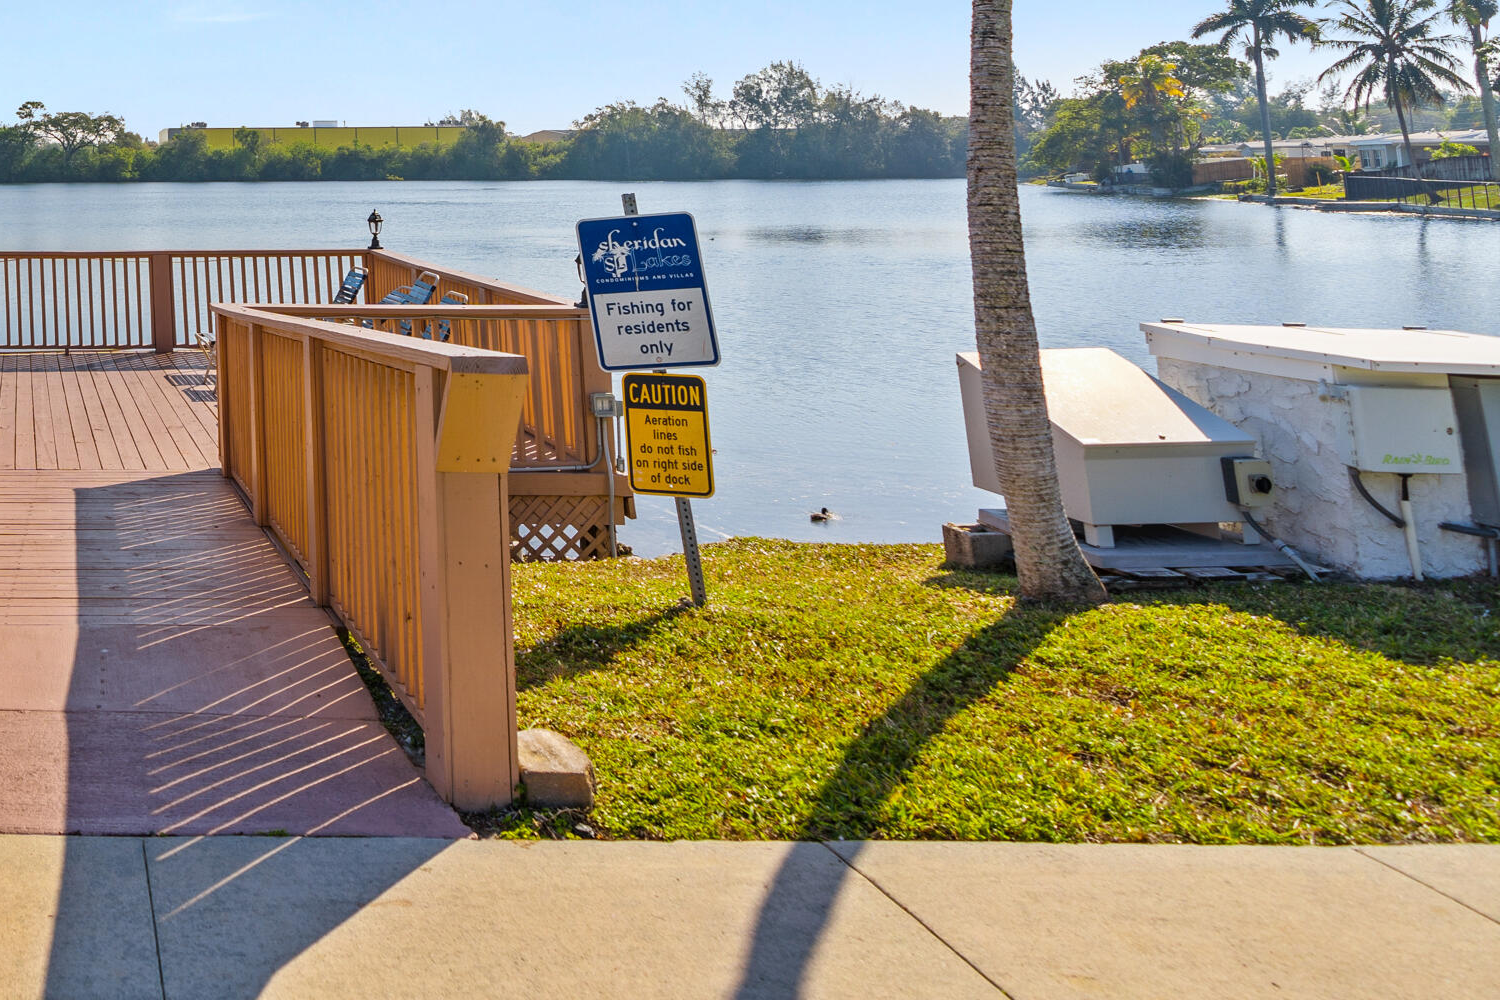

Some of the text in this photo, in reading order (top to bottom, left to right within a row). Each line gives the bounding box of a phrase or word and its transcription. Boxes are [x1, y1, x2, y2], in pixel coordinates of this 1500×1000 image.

[632, 246, 692, 272] Lakes
[606, 299, 693, 316] Fishing for
[617, 320, 690, 335] residents
[640, 340, 673, 356] only
[628, 383, 700, 406] CAUTION
[644, 414, 688, 427] Aeration
[653, 430, 678, 441] lines
[640, 444, 697, 456] do not fish
[636, 459, 703, 472] on right side
[651, 474, 691, 485] of dock
